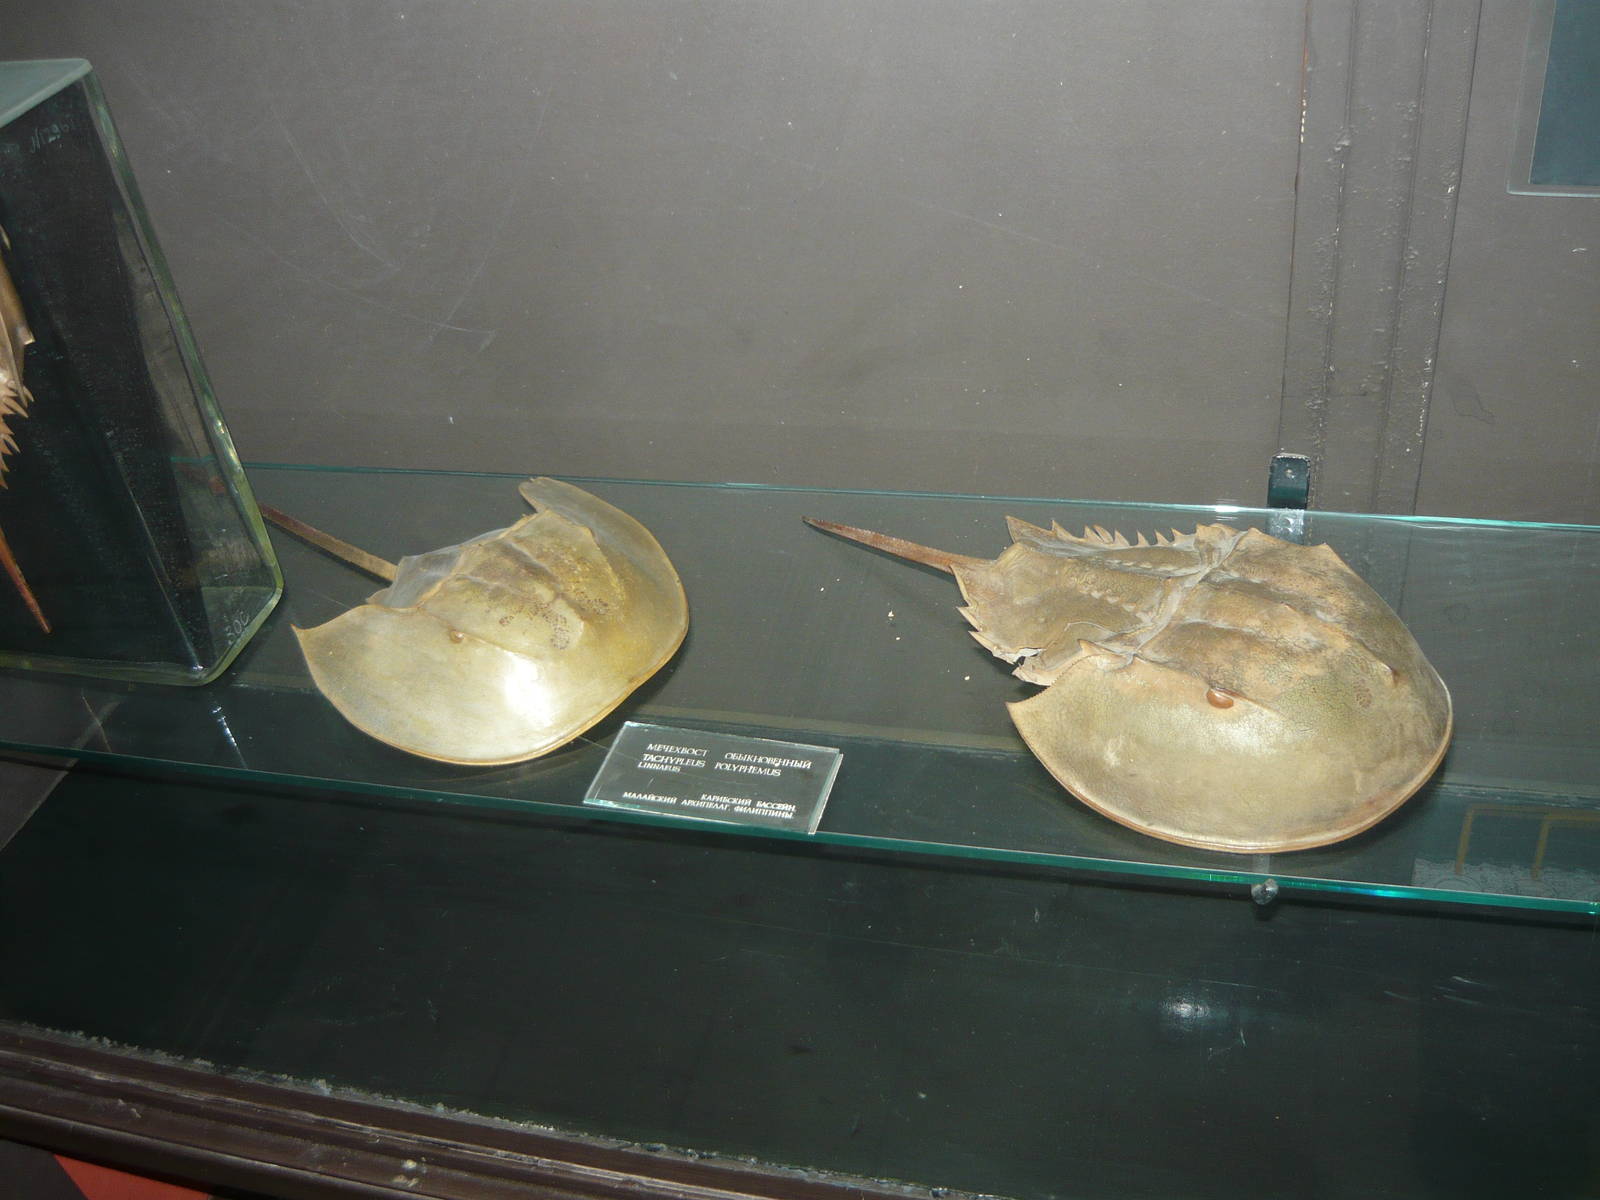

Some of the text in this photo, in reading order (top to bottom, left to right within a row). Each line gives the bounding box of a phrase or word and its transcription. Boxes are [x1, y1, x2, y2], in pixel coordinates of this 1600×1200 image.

[642, 753, 781, 776] TACHYPLEUS POLYPHEMUS
[646, 743, 813, 769] МЕЧЕХВОСТ ОБЫКНОВЕННЫЙ
[623, 791, 678, 804] МАЛАЙСКИЙ
[701, 793, 752, 807] КАРИБСКИЙ
